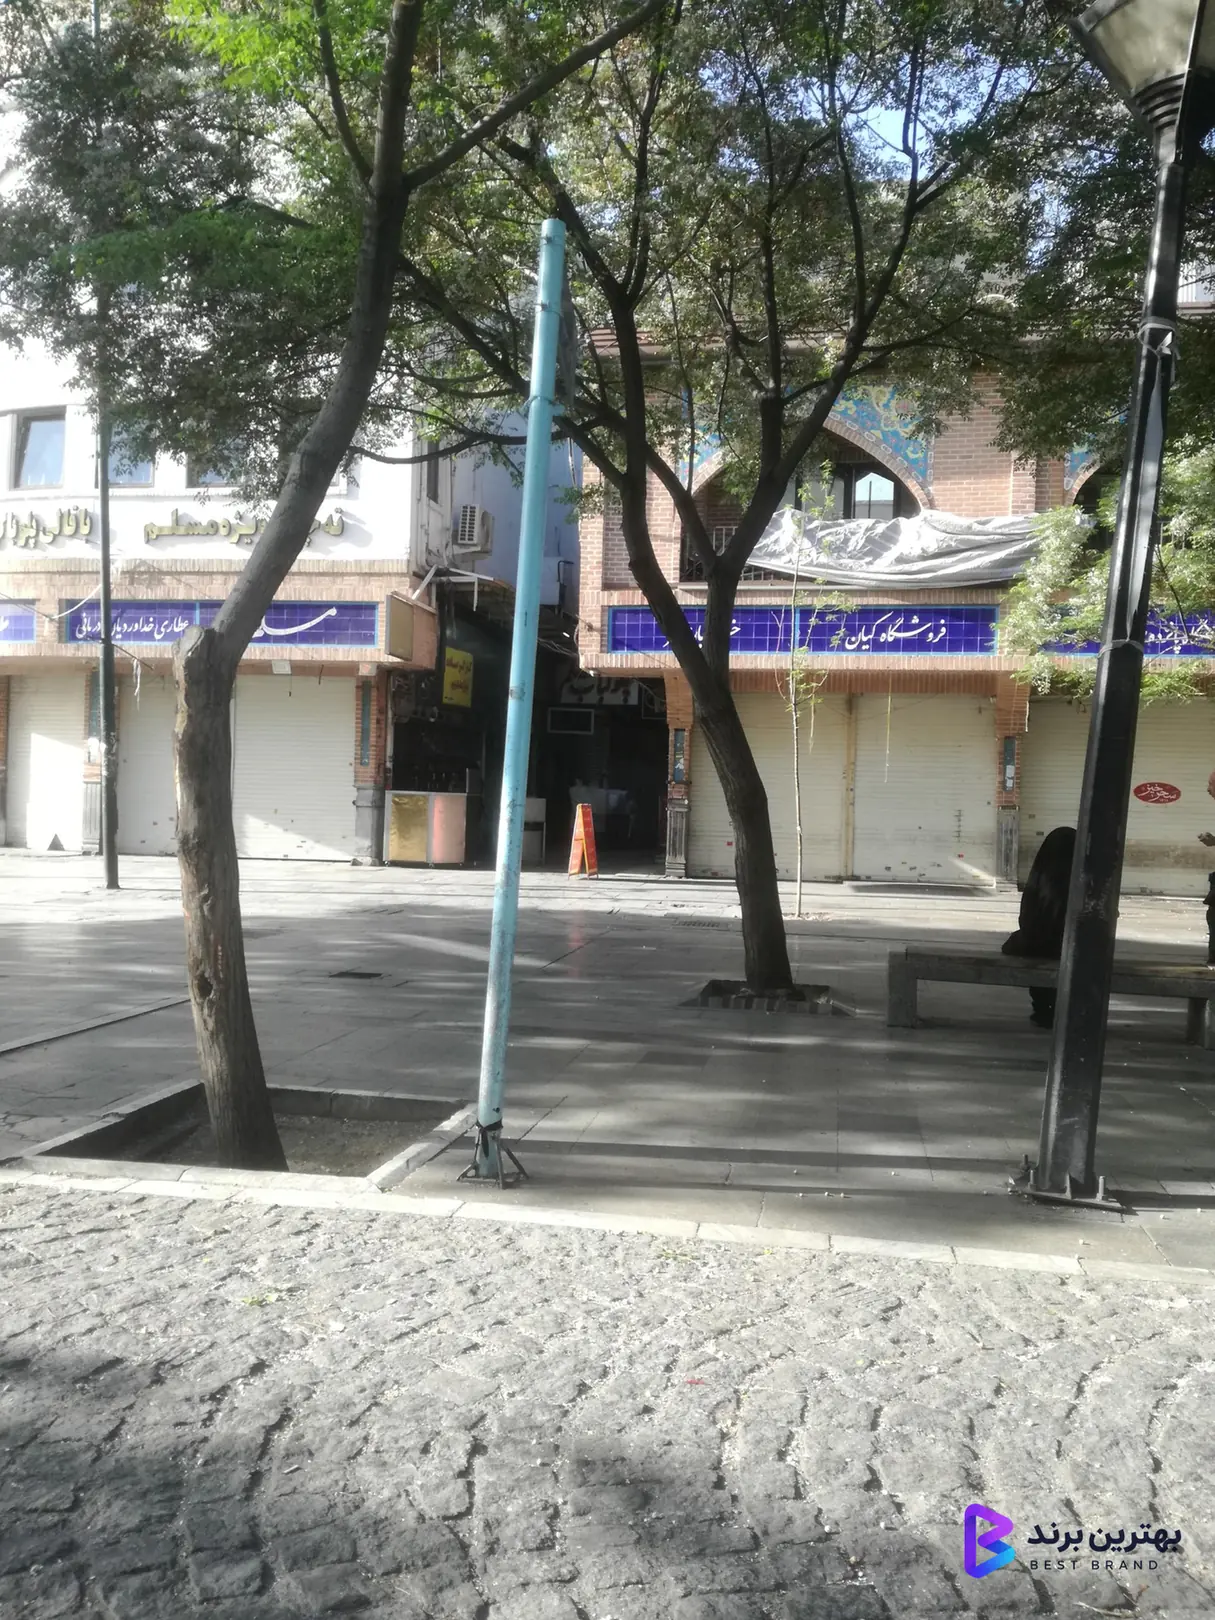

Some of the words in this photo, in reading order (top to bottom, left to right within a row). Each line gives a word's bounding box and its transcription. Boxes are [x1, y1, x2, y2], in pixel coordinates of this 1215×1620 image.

[154, 616, 189, 639] عطاری
[844, 611, 894, 650] کیان
[879, 615, 947, 643] فروشگاه
